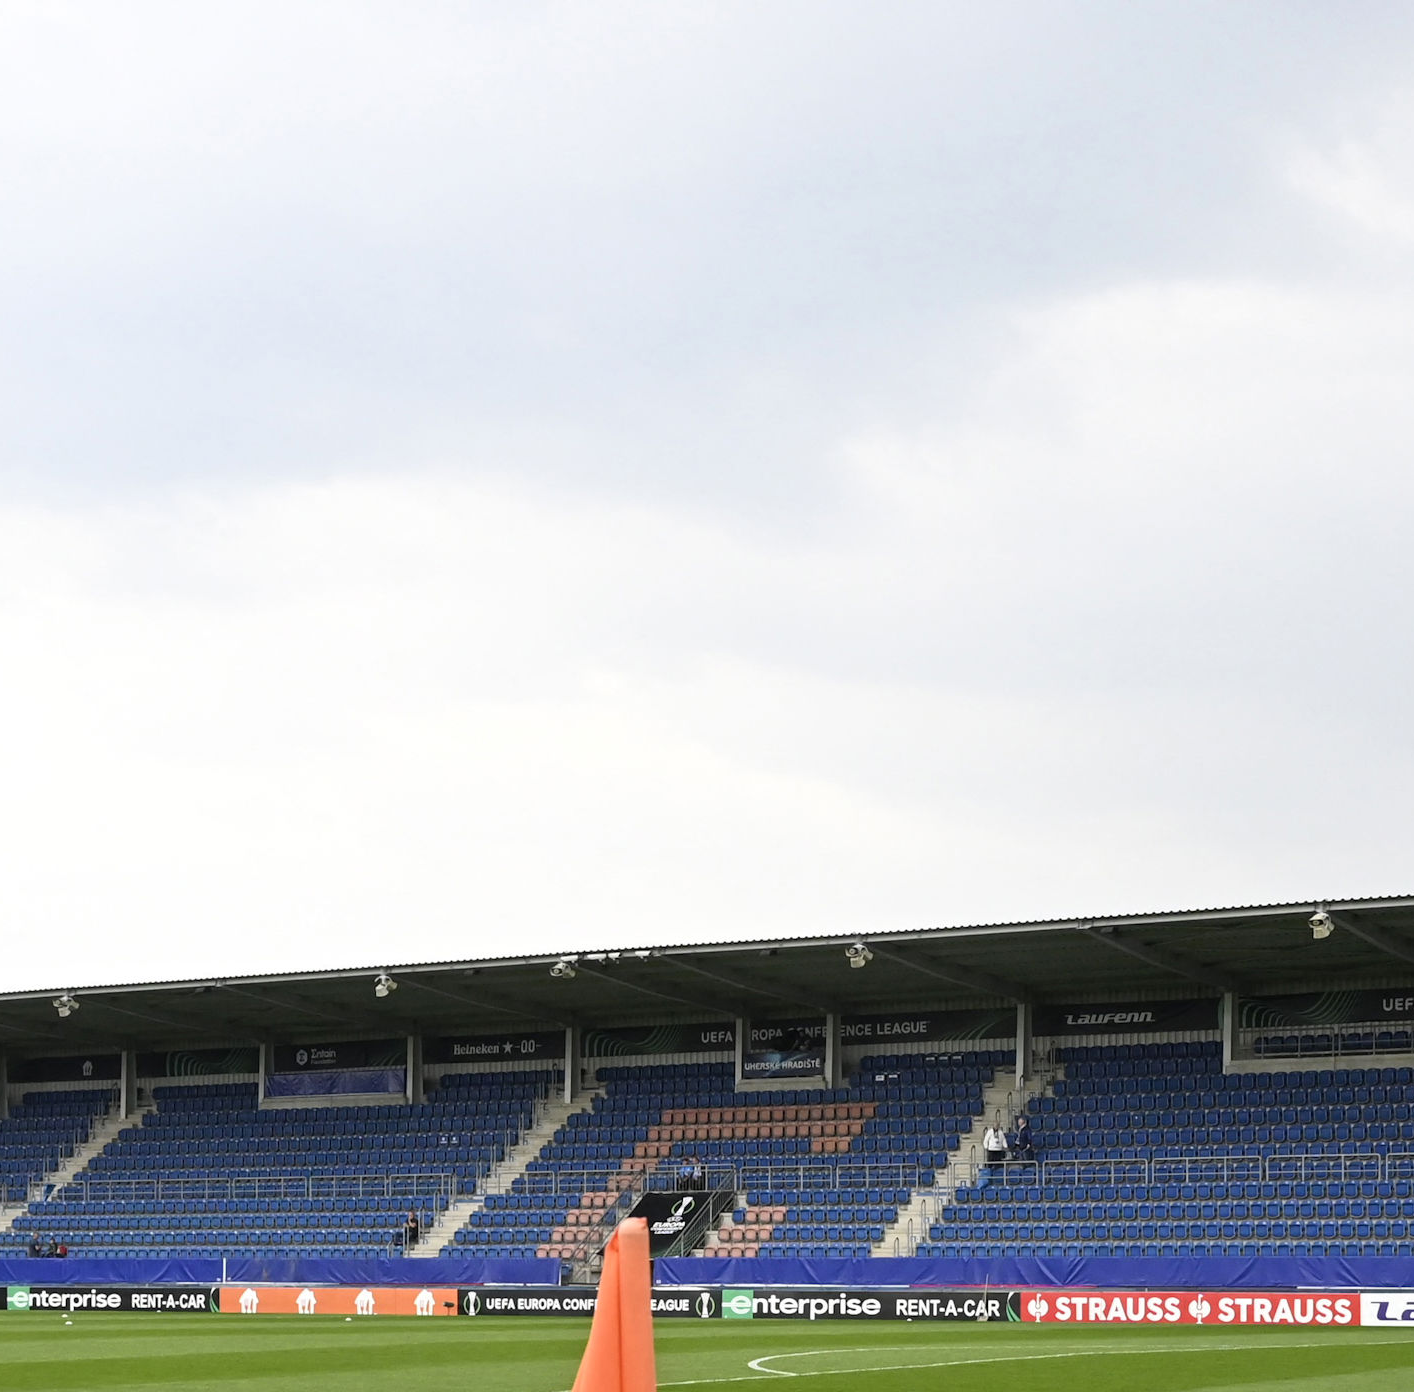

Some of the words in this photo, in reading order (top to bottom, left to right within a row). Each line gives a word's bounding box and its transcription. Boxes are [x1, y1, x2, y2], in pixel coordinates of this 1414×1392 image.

[1065, 1011, 1155, 1025] Laufenn
[701, 1030, 733, 1044] UEFA
[876, 1020, 928, 1036] LEAGUE
[453, 1044, 500, 1056] Heineken
[782, 1057, 821, 1069] HRADIŠTĚ
[7, 1289, 122, 1311] enterprise
[131, 1293, 205, 1309] RENT-A-CAR
[485, 1298, 517, 1310] UEFA
[518, 1298, 560, 1311] EUROPA
[650, 1299, 690, 1312] EAGUE
[722, 1292, 882, 1321] enterprise
[895, 1299, 1000, 1317] RENT-A-CAR
[1054, 1297, 1181, 1322] STRAUSS
[1217, 1297, 1352, 1325] STRAUSS
